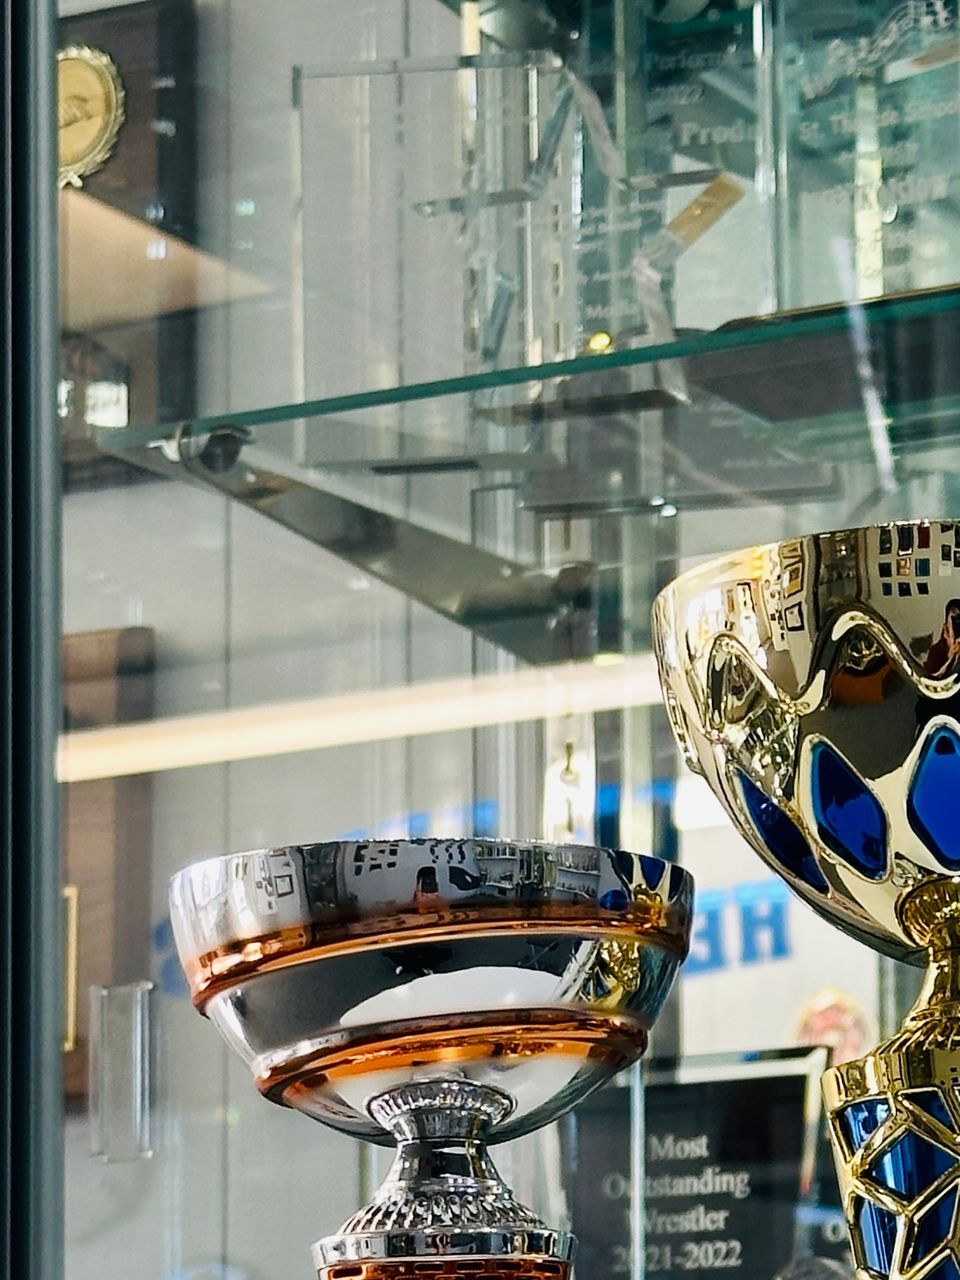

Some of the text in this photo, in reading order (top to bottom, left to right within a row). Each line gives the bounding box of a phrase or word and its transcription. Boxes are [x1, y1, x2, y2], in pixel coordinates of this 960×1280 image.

[650, 1134, 709, 1161] Most
[602, 1166, 751, 1199] Otstanding
[612, 1239, 743, 1273] 221-2022
